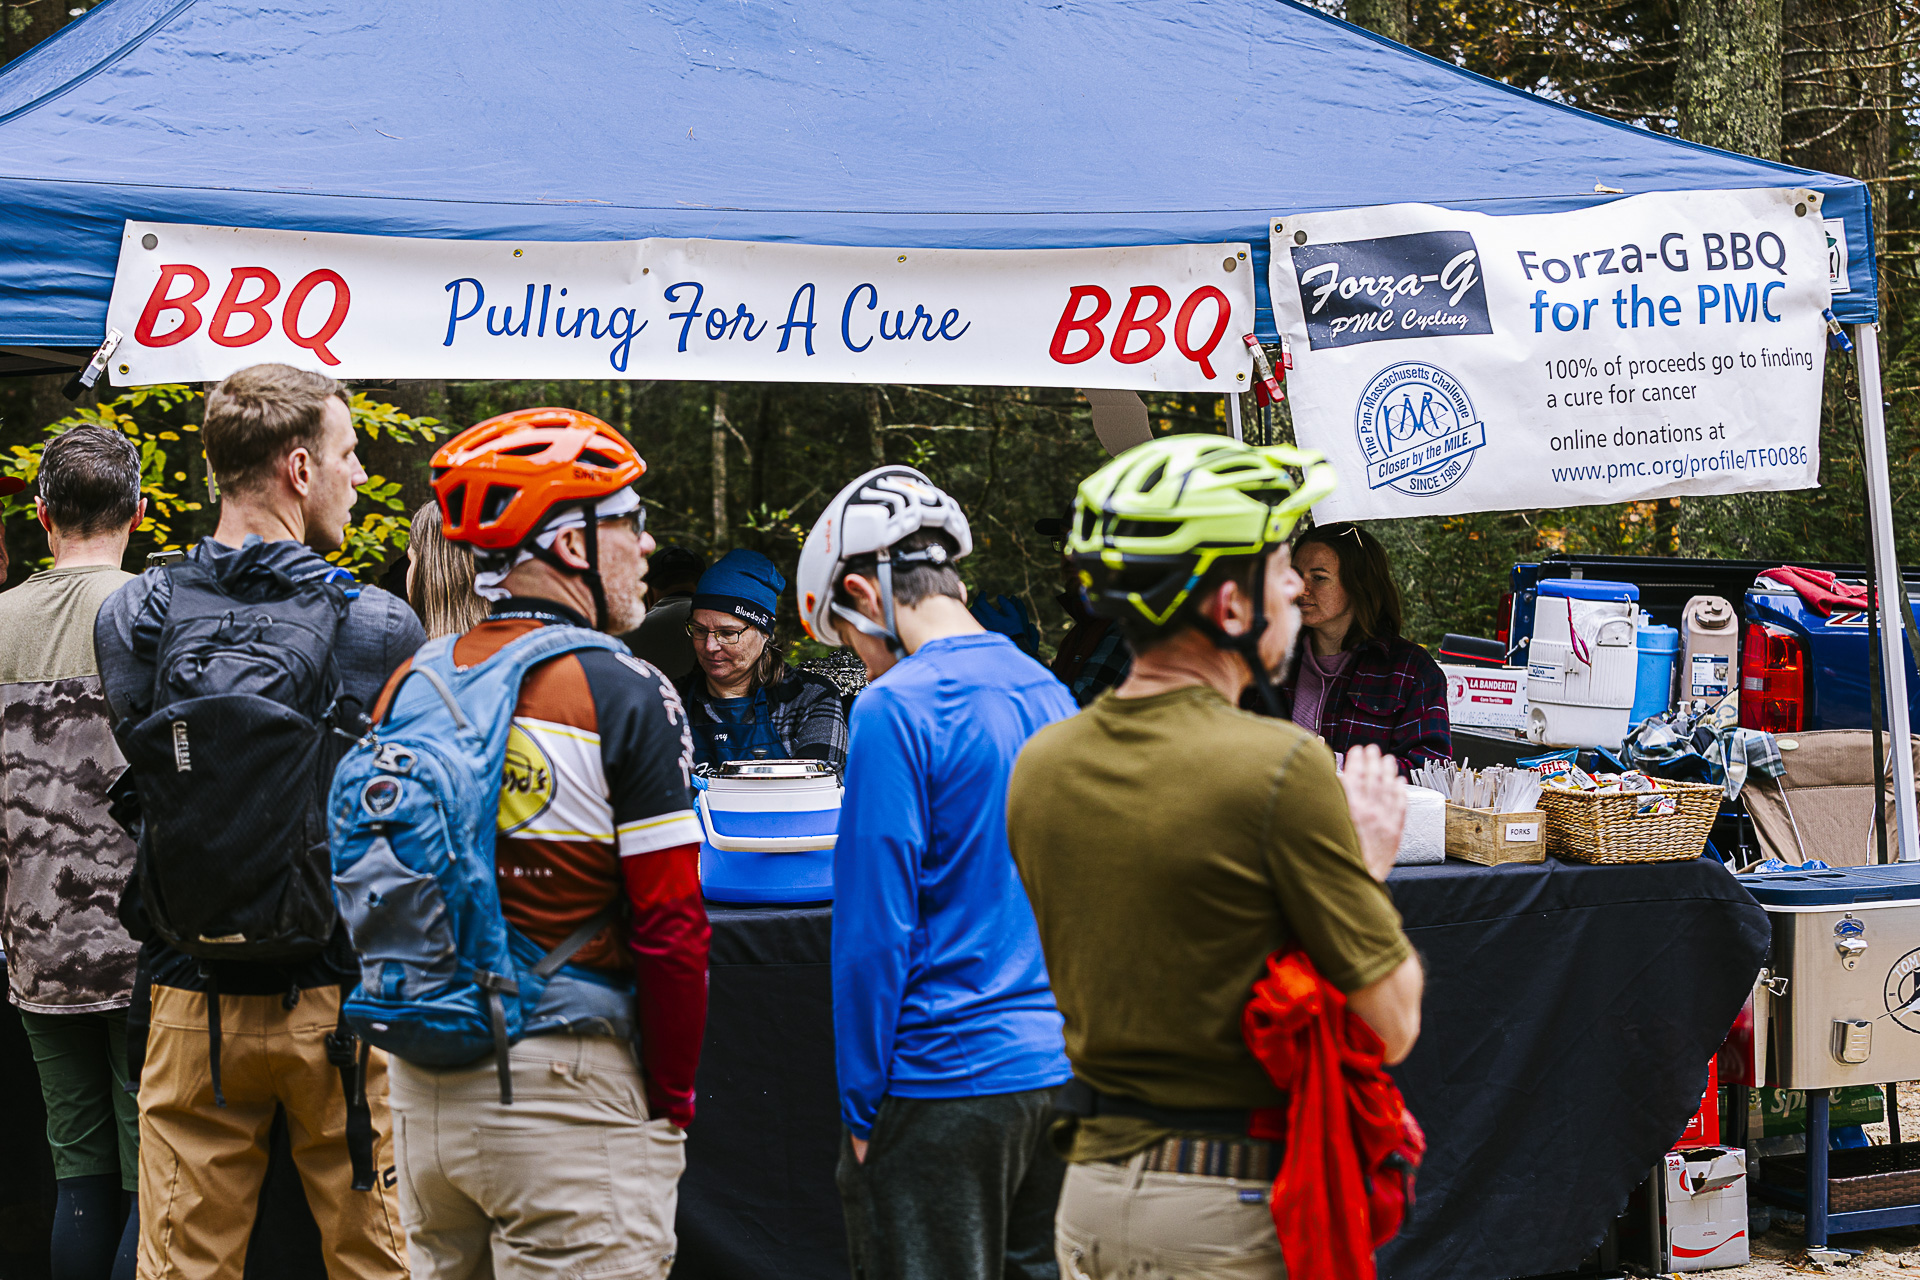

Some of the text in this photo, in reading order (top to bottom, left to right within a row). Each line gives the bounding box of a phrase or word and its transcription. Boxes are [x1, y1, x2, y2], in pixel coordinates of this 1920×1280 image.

[1517, 231, 1787, 284] Forza-G BBQ
[1301, 249, 1479, 315] Forza-G
[134, 264, 351, 366] BBQ
[1330, 308, 1470, 338] PMC Cycling
[1529, 281, 1786, 334] for the PMC
[442, 277, 972, 373] Pulling For A Cure
[1048, 284, 1233, 381] BBQ
[1545, 347, 1813, 380] 100% of proceeds go to finding
[1546, 384, 1697, 408] a cure for cancer
[1360, 367, 1470, 459] The Pan-Massachusetts Challenge
[1550, 422, 1726, 451] online donations at
[1379, 456, 1411, 478] Closer
[1412, 451, 1424, 466] by
[1426, 444, 1442, 460] the
[1409, 460, 1462, 491] SINCE 1980
[1551, 445, 1809, 484] www.pmc.org/profile/TF0086
[1469, 679, 1479, 689] LA
[1480, 680, 1516, 692] BANDERITA
[1510, 828, 1531, 836] FORKS
[1892, 952, 1920, 980] TOM
[1668, 1159, 1680, 1167] 24
